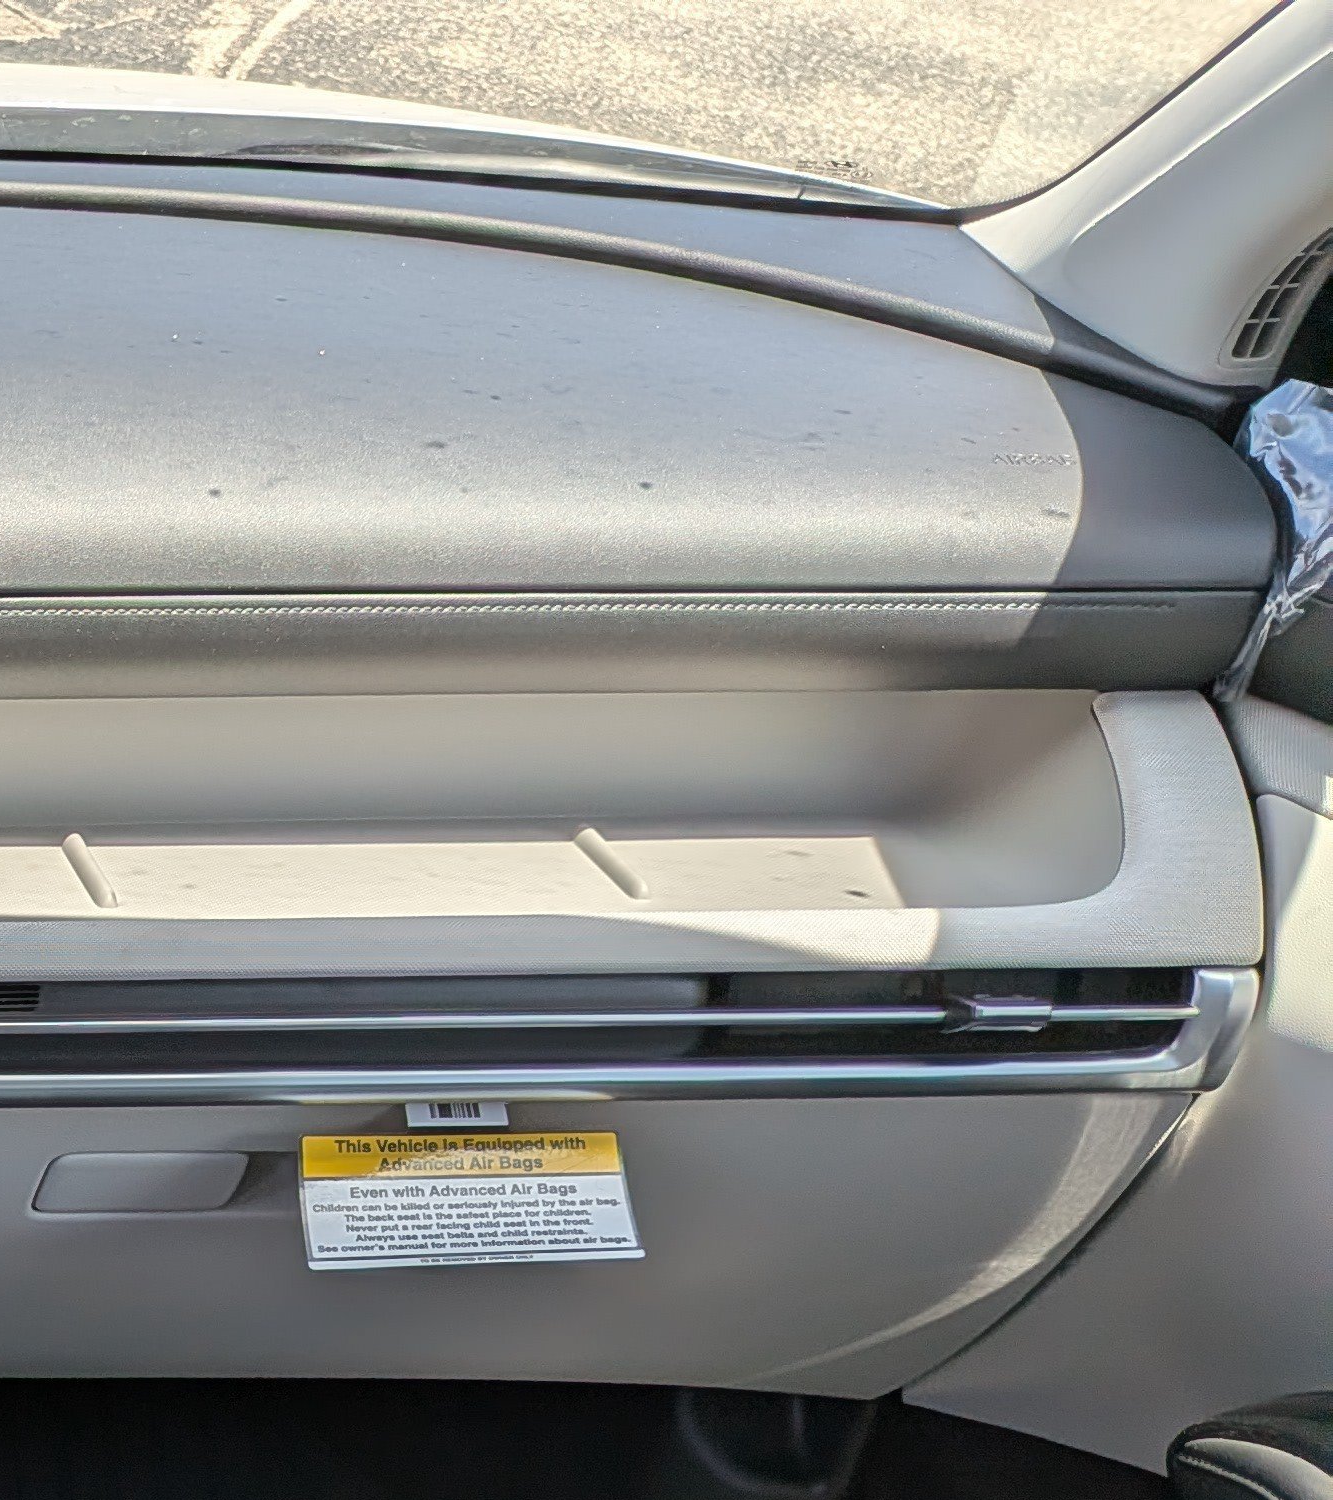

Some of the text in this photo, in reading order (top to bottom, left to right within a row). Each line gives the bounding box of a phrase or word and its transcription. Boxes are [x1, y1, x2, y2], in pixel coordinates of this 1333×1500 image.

[334, 1139, 371, 1153] This
[376, 1138, 438, 1153] Vehicle
[463, 1137, 545, 1153] Equipped
[550, 1136, 586, 1150] with
[378, 1156, 544, 1172] Advanced Air Bags
[350, 1183, 577, 1199] Even with Advanced Air Bags
[312, 1204, 359, 1213] Children
[362, 1204, 381, 1212] can
[385, 1203, 398, 1211] be
[401, 1202, 430, 1211] killed
[448, 1200, 497, 1210] seriously
[501, 1199, 539, 1209] injured
[542, 1199, 556, 1209] by
[559, 1199, 576, 1207] the
[580, 1198, 593, 1206] air
[596, 1197, 620, 1207] bag.
[344, 1214, 365, 1222] The
[368, 1213, 394, 1222] back
[397, 1213, 420, 1221] seat
[435, 1211, 453, 1220] the
[456, 1210, 489, 1219] safest
[493, 1210, 522, 1219] place
[525, 1209, 539, 1217] for
[543, 1208, 591, 1217] children.
[346, 1224, 377, 1232] Never
[381, 1224, 399, 1233] put
[436, 1222, 470, 1231] facing
[473, 1220, 500, 1229] child
[503, 1220, 526, 1228] seat
[543, 1219, 560, 1227] the
[356, 1233, 395, 1243] Always
[398, 1233, 418, 1241] use
[422, 1232, 444, 1240] seat
[448, 1231, 474, 1240] belts
[478, 1230, 498, 1238] and
[501, 1229, 528, 1237] child
[318, 1245, 338, 1253] See
[341, 1243, 385, 1252] owner's
[388, 1241, 428, 1250] manual
[431, 1241, 446, 1249] for
[450, 1240, 478, 1248] more
[481, 1238, 545, 1247] information
[548, 1237, 580, 1245] about
[583, 1236, 597, 1244] air
